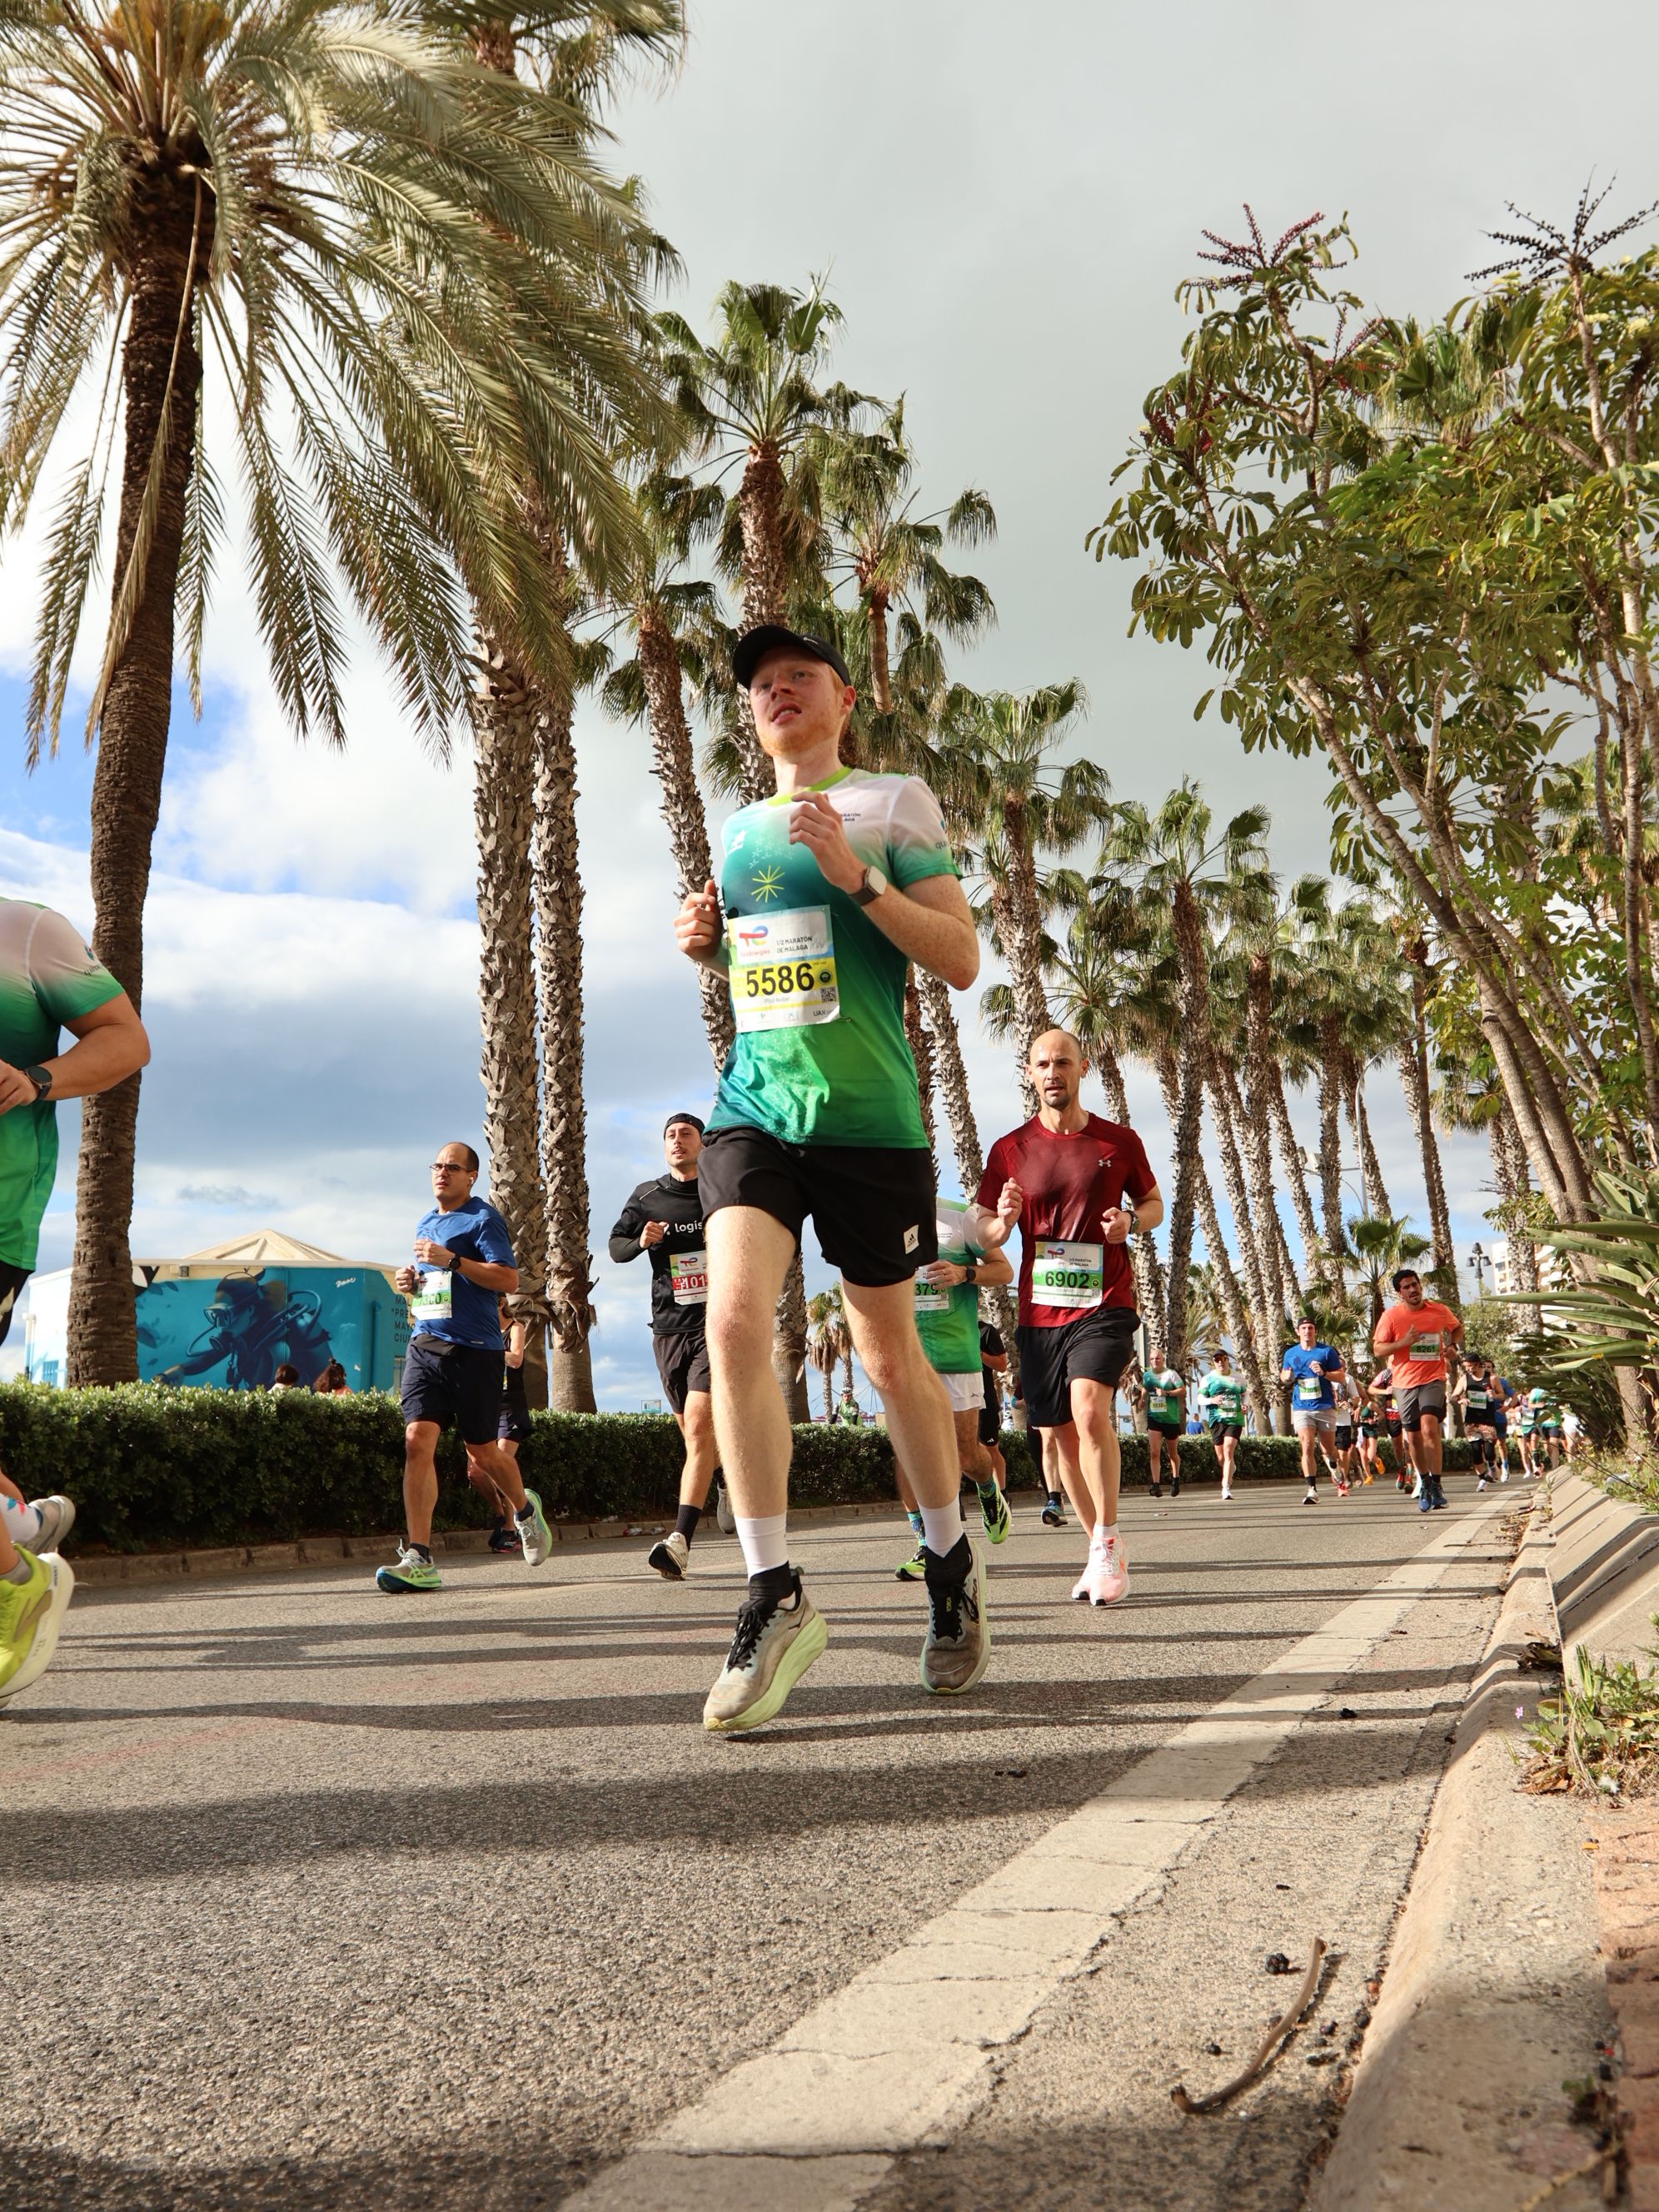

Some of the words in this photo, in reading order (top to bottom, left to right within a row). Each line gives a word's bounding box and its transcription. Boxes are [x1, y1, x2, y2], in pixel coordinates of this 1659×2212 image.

[934, 840, 946, 850] qu
[785, 935, 813, 944] MARATÓN
[746, 962, 815, 998] 5586
[675, 1220, 703, 1233] logís
[682, 1273, 708, 1289] 101
[1045, 1271, 1089, 1289] 6902
[914, 1283, 939, 1296] 379
[395, 1321, 416, 1332] MAYO
[394, 1333, 411, 1343] CIU
[1416, 1345, 1436, 1353] 8261
